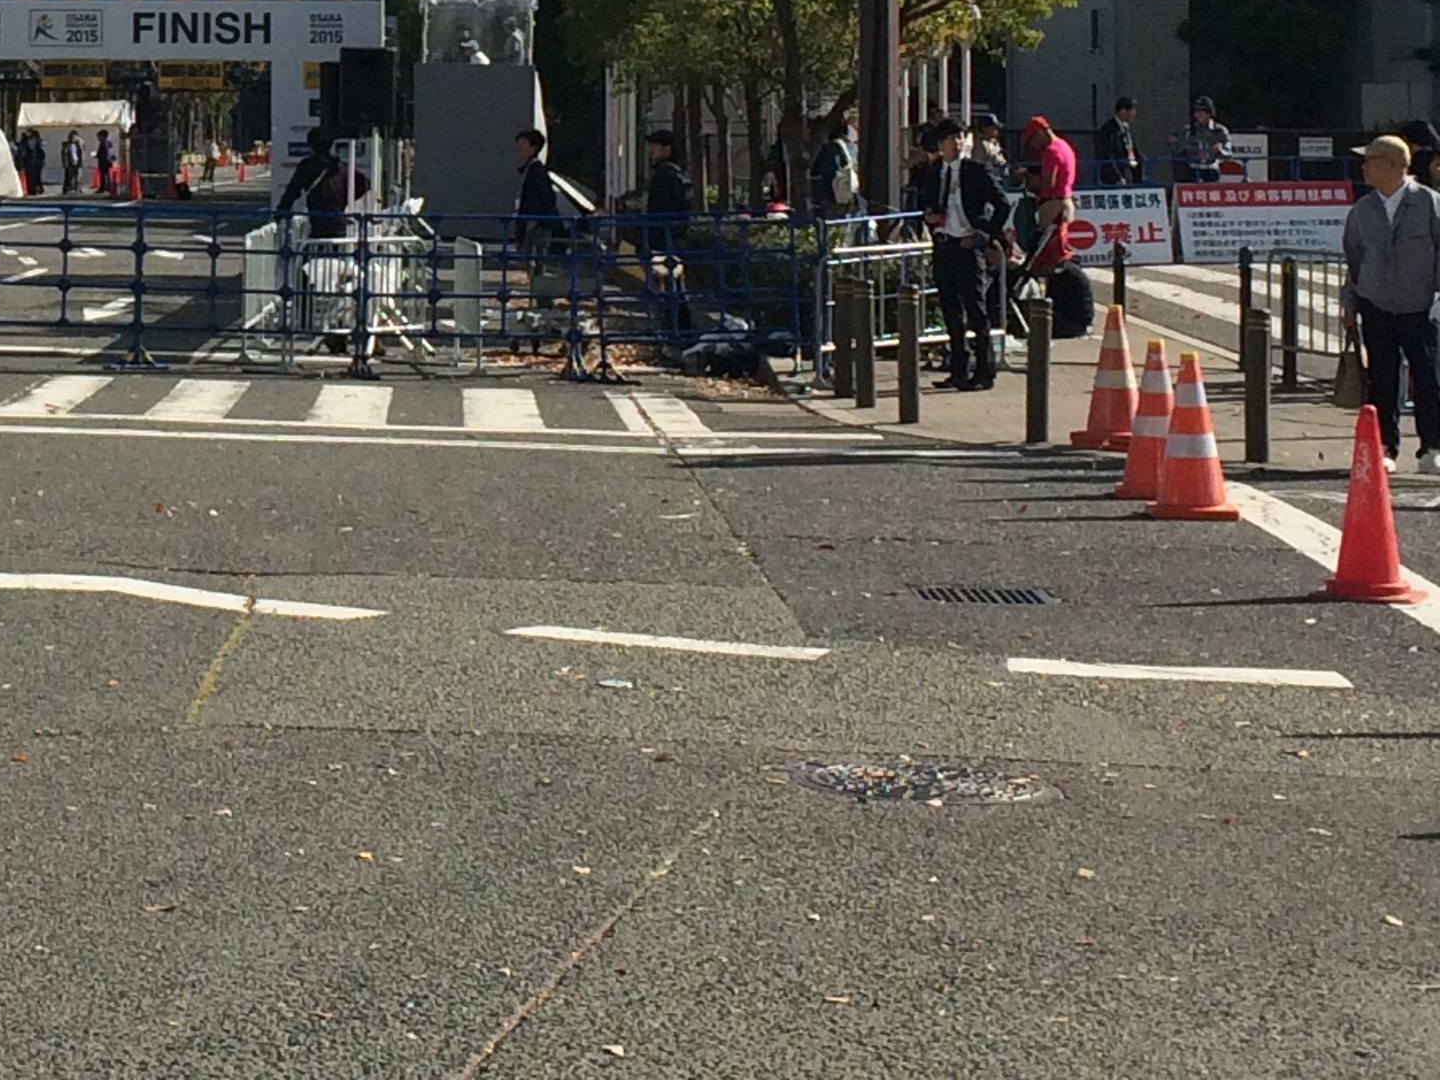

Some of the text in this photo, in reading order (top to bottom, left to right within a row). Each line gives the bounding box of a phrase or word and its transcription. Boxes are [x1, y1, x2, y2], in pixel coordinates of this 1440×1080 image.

[66, 29, 99, 42] 2015
[133, 12, 271, 44] FINISH
[309, 30, 343, 44] 2015
[1100, 222, 1166, 244] 禁止
